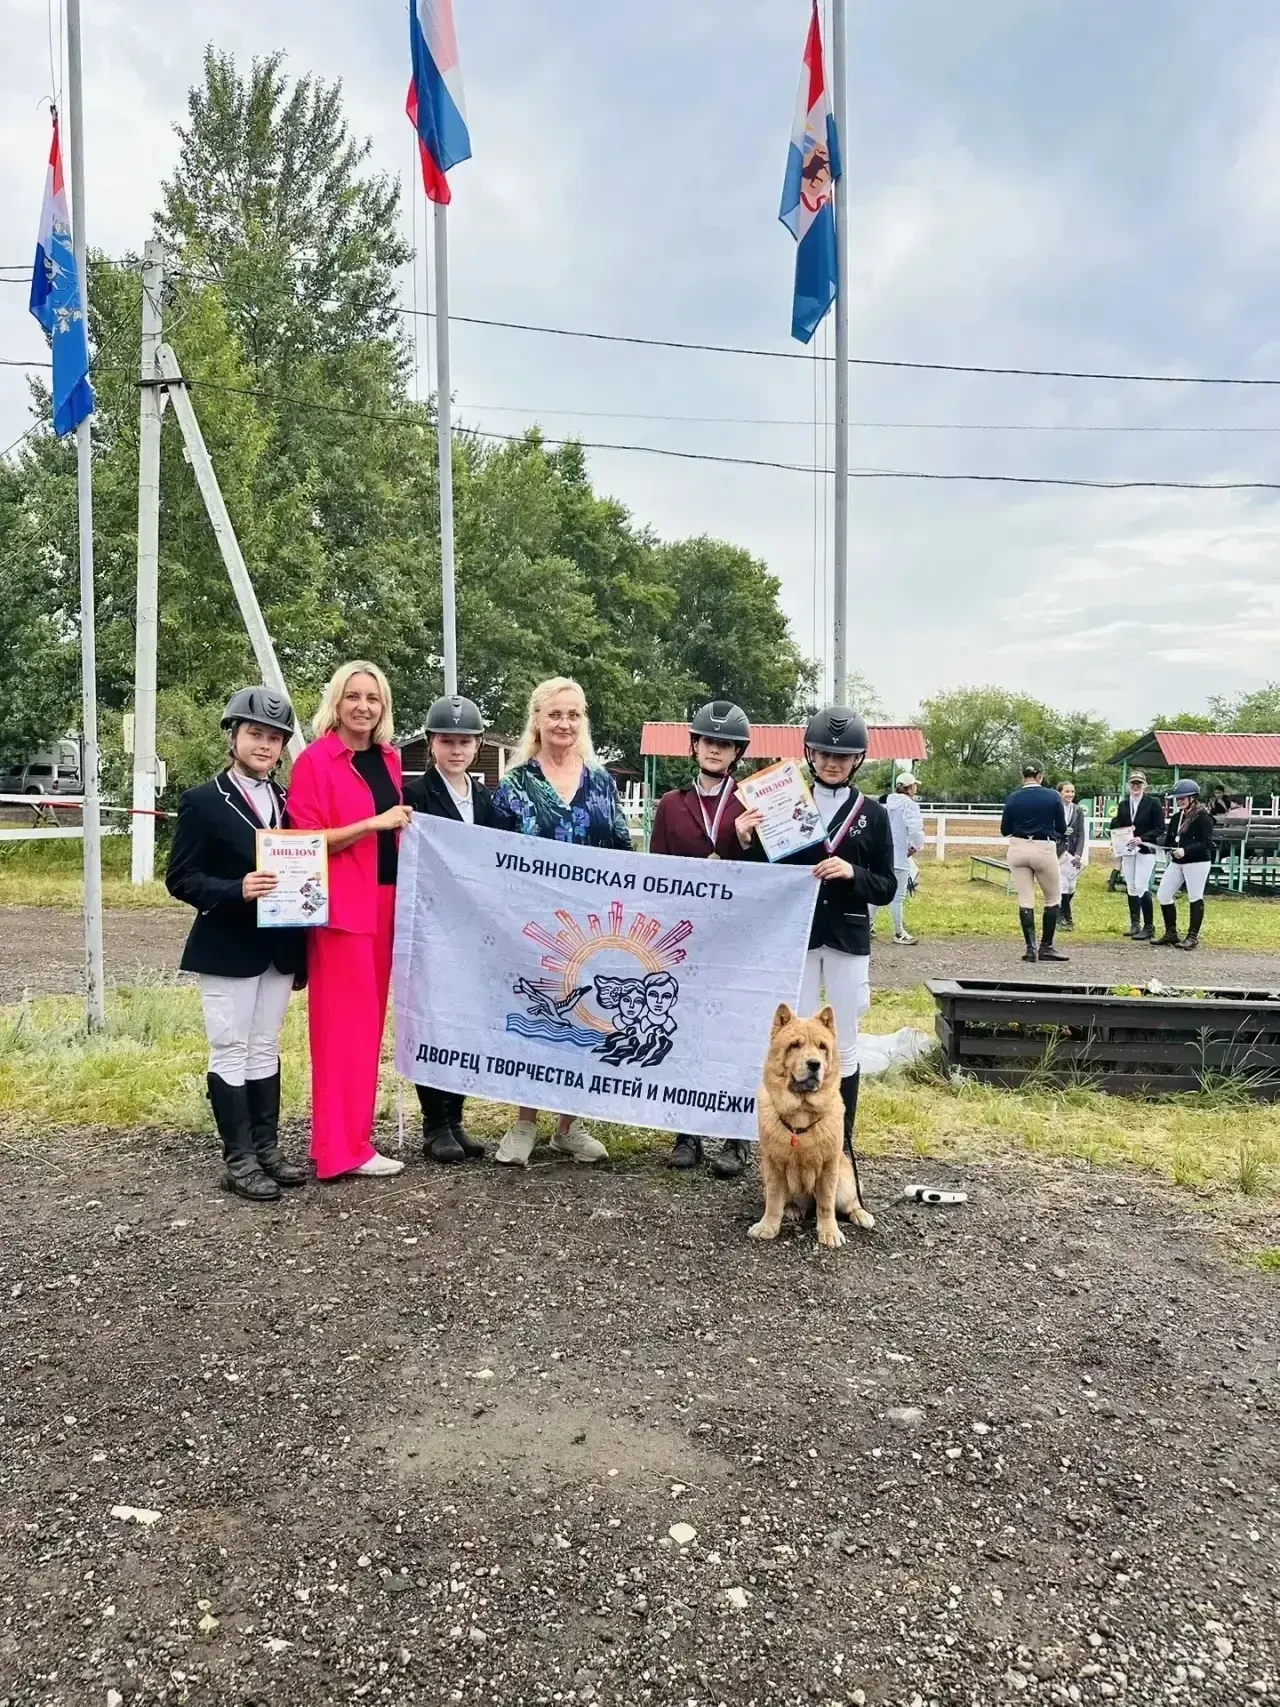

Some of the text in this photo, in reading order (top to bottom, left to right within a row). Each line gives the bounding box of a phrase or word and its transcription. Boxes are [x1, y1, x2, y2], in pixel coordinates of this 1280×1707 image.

[755, 776, 793, 798] ДИПЛОМ
[269, 848, 316, 856] ДИПЛОМ
[495, 852, 733, 901] УЛЬЯНОВСКАЯ ОБЛАСТЬ
[416, 1044, 755, 1115] ДВОРЕЦ ТВОРЧЕСТВА ДЕТЕЙ И МОЛОДЁЖИ
